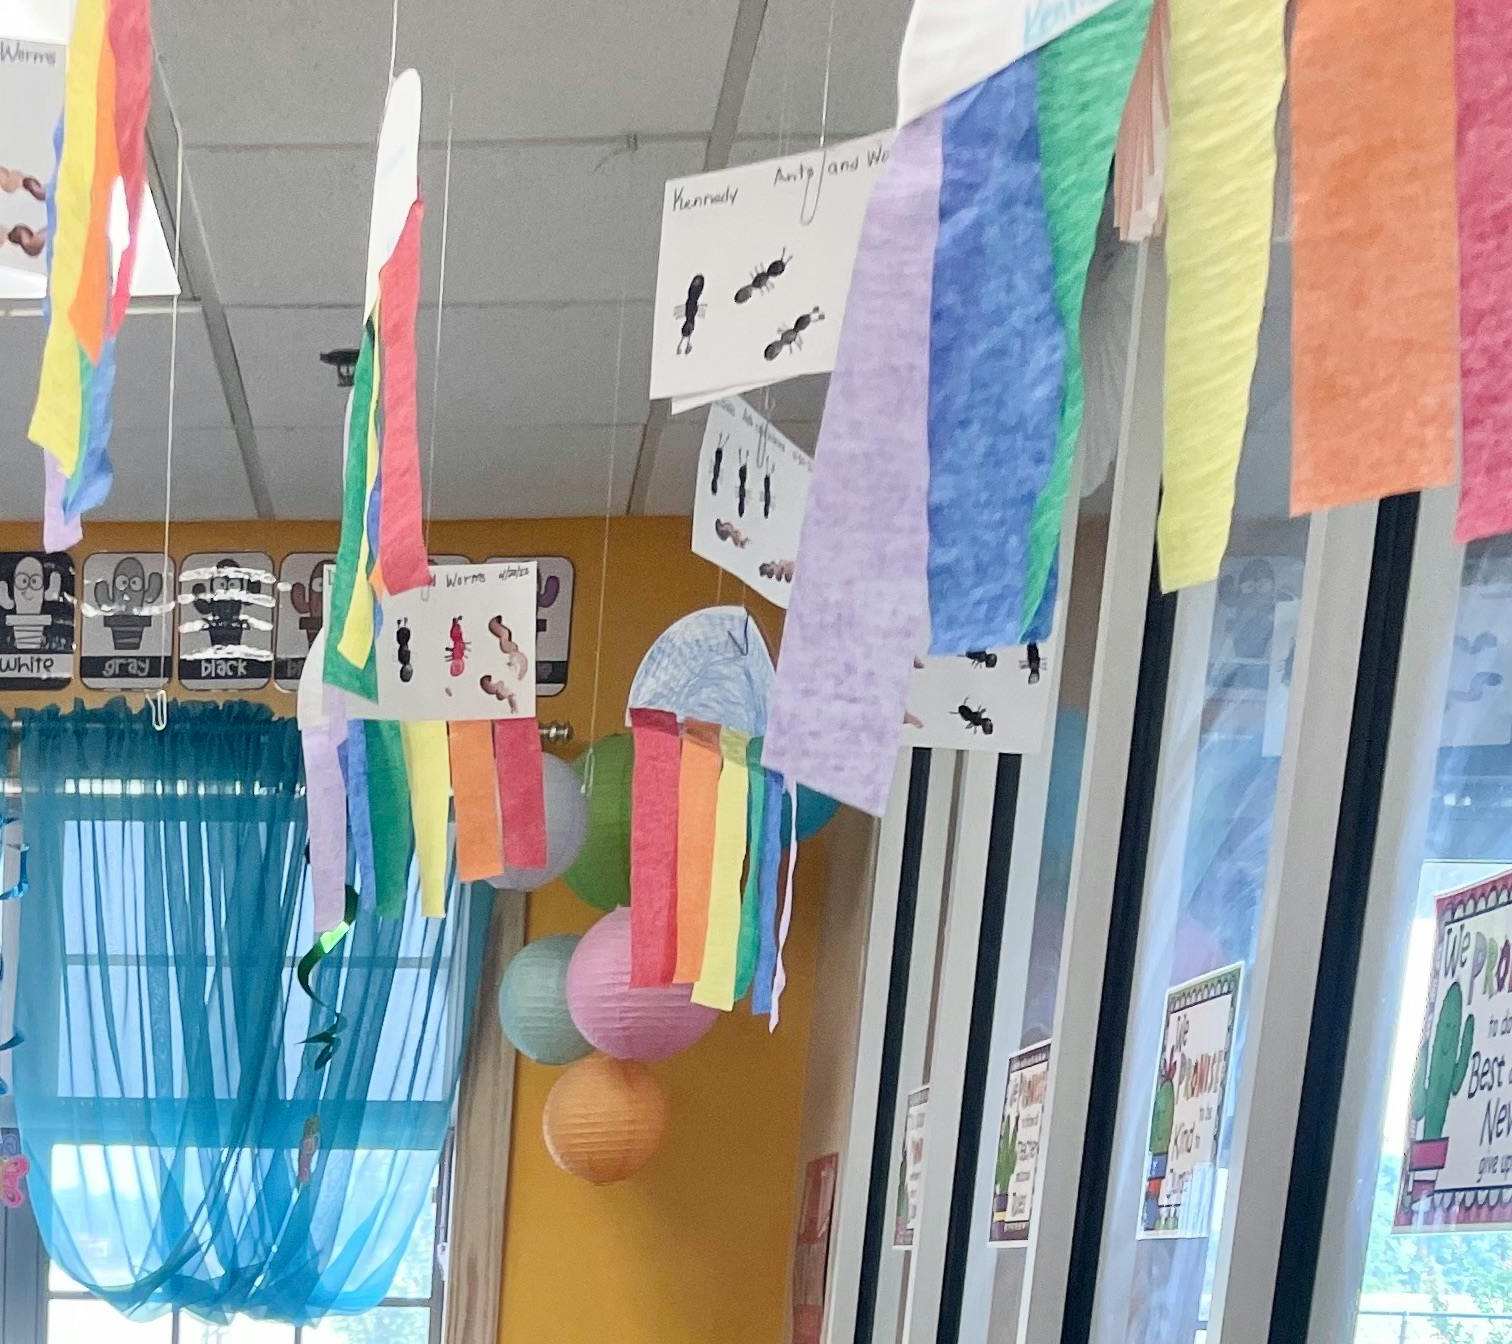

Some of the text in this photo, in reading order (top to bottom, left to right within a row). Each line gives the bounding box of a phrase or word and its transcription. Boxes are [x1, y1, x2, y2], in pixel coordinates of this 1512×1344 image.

[828, 156, 859, 175] and
[102, 658, 150, 677] gray
[200, 658, 248, 679] black
[1443, 924, 1471, 978] We
[1467, 1050, 1506, 1100] Best
